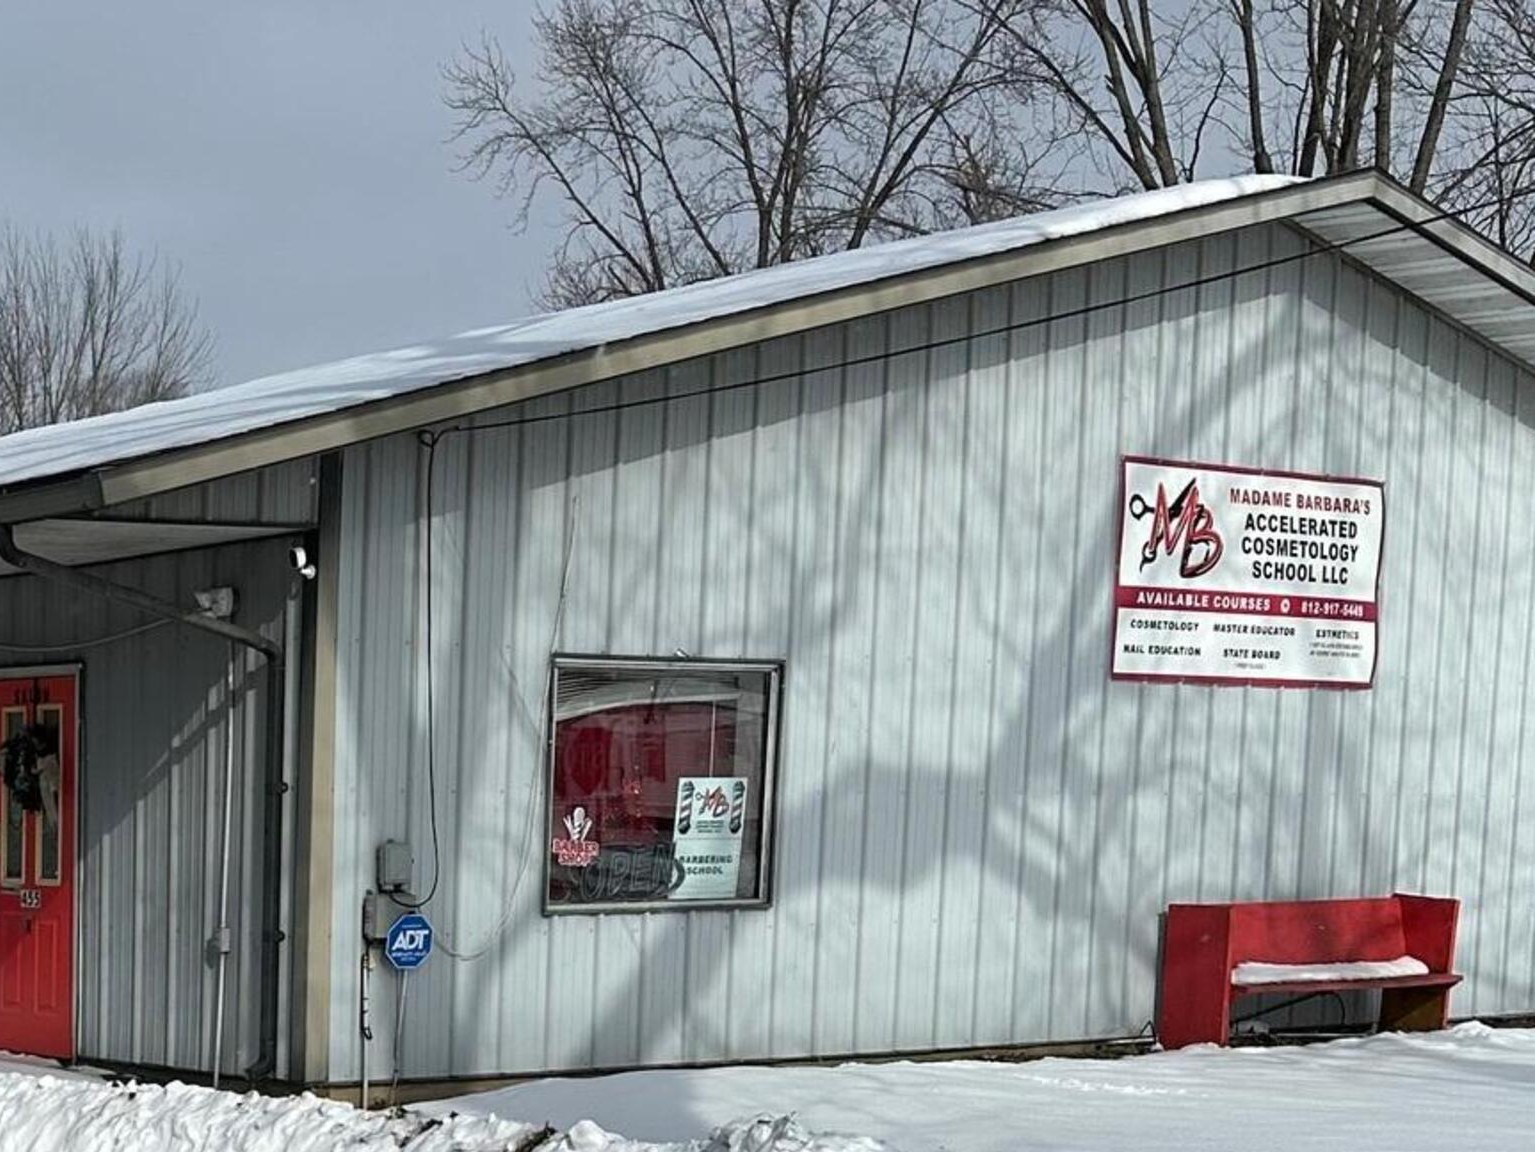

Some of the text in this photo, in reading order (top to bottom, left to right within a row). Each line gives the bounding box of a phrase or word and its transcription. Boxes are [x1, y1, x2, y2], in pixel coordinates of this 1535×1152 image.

[1230, 488, 1371, 515] MADAME BARBARA'S
[1244, 513, 1358, 539] ACCELERATED
[1241, 536, 1358, 562] COSMETOLOGY
[1252, 560, 1349, 584] SCHOOL LLC
[1136, 591, 1271, 611] AVAILABLE COURSES
[1130, 619, 1199, 631] COSMETOLOGY
[1213, 623, 1295, 636] MASTER EDUCATOR
[1123, 644, 1201, 656] NAIL EDUCATION
[1223, 648, 1281, 660] STATE BOARD
[392, 930, 429, 950] ADT
